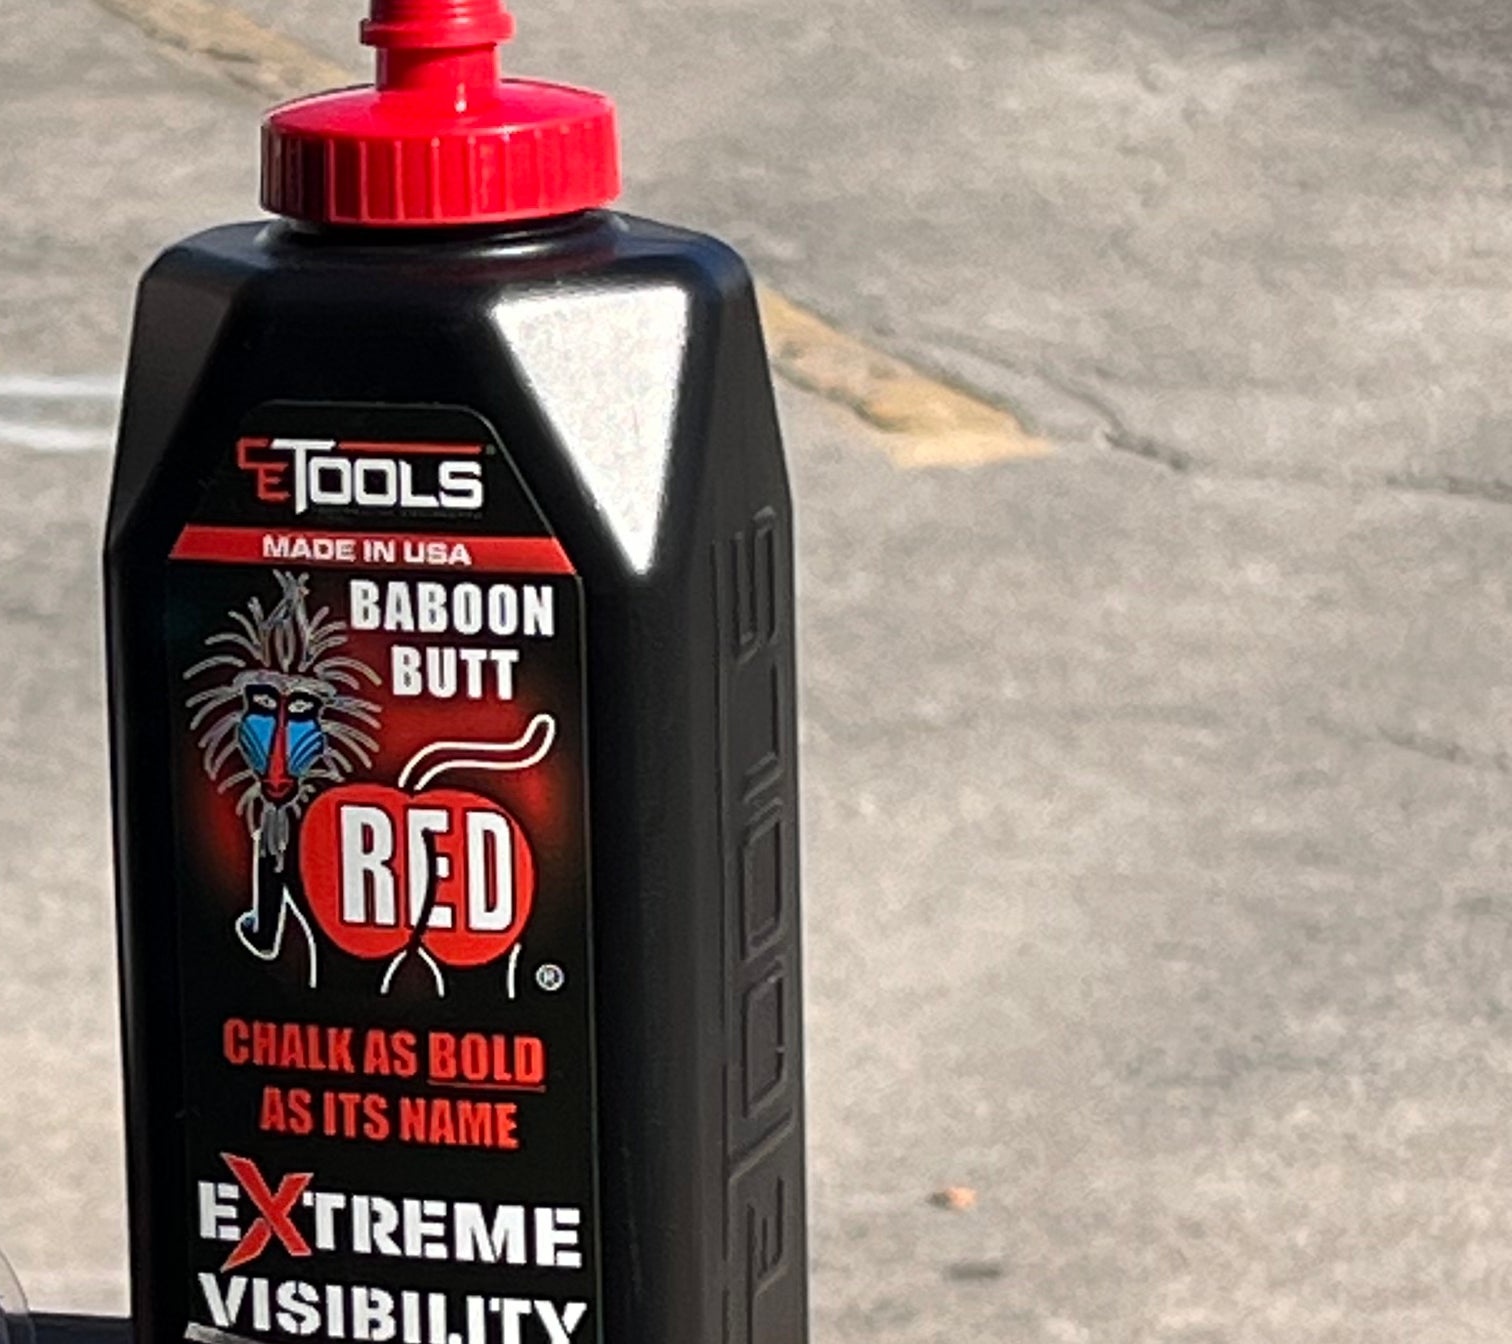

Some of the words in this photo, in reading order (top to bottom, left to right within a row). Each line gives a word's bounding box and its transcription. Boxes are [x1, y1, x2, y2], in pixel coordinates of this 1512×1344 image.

[262, 534, 355, 562] MADE
[364, 537, 395, 564] IN
[403, 540, 472, 567] USA
[349, 579, 555, 637] BABOON
[391, 645, 519, 701] BUTT
[339, 805, 514, 932] RED
[223, 1017, 355, 1074] CHALK
[363, 1027, 418, 1078] AS
[428, 1031, 546, 1084] BOLD
[260, 1085, 314, 1136] AS
[322, 1090, 390, 1143] ITS
[399, 1096, 520, 1150] NAME
[197, 1152, 583, 1273] EXTREME
